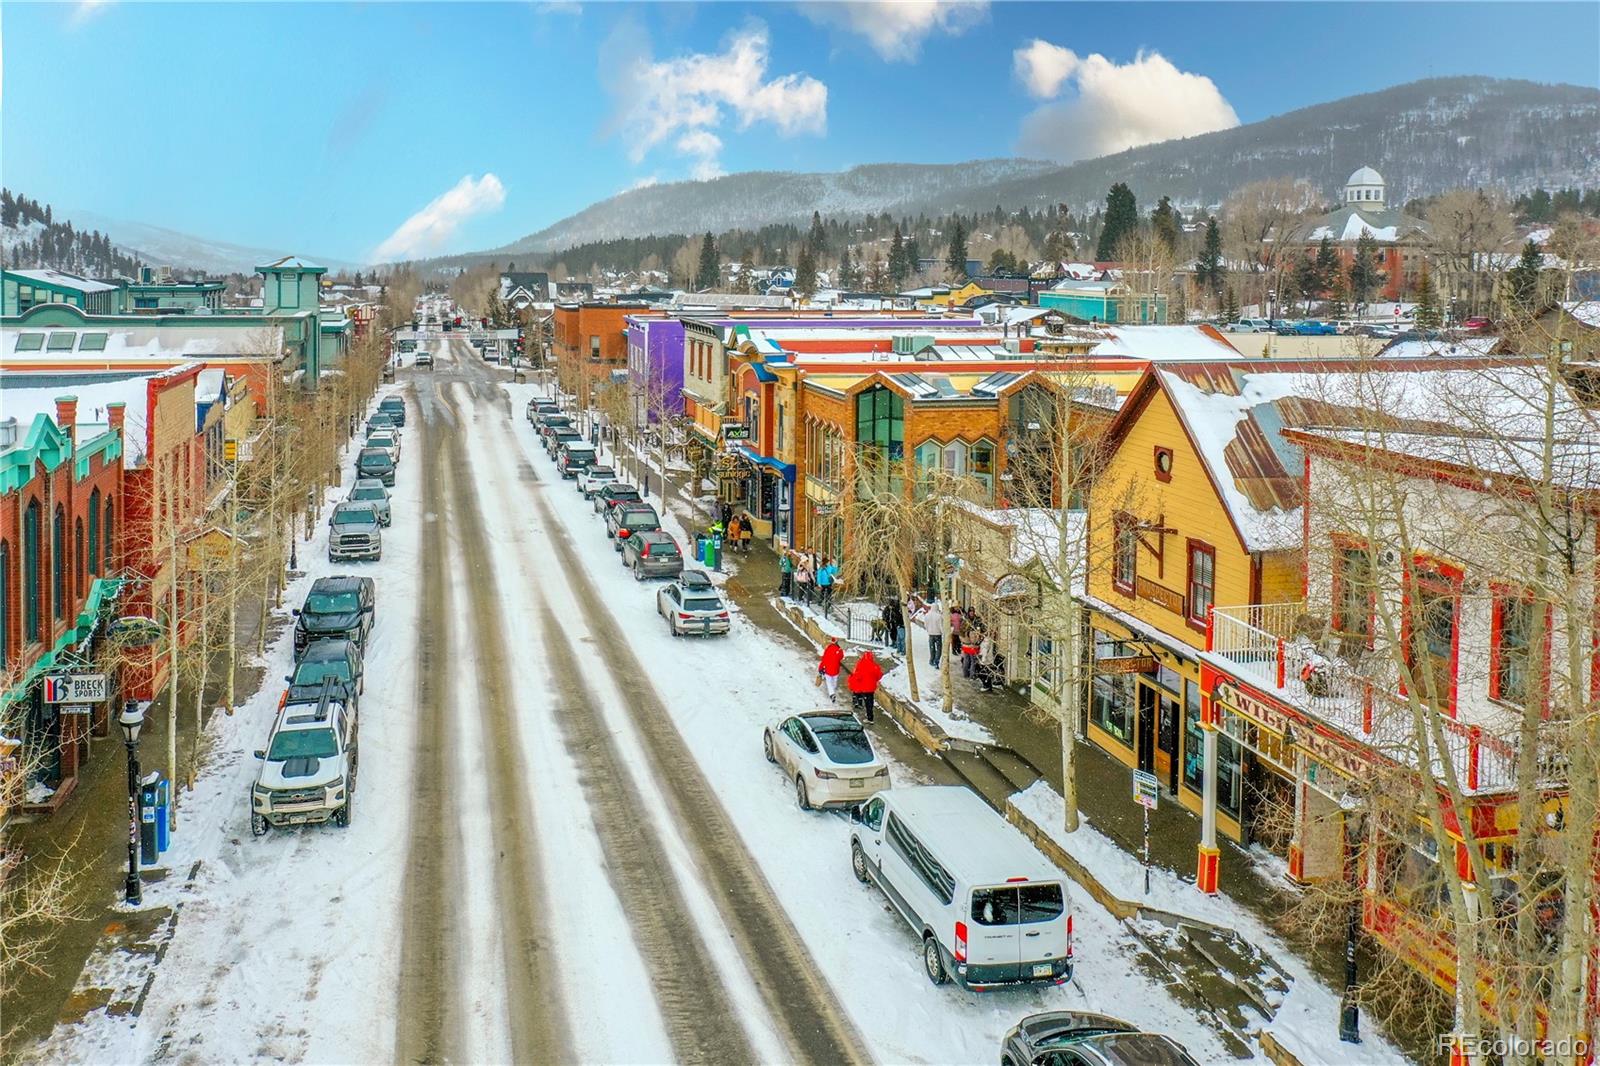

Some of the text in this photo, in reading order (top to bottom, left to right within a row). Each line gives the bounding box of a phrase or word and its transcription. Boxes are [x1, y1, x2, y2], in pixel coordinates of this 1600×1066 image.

[727, 430, 749, 438] AXIS
[74, 679, 104, 690] BRECK
[74, 689, 102, 698] SPORTS
[145, 793, 152, 802] P
